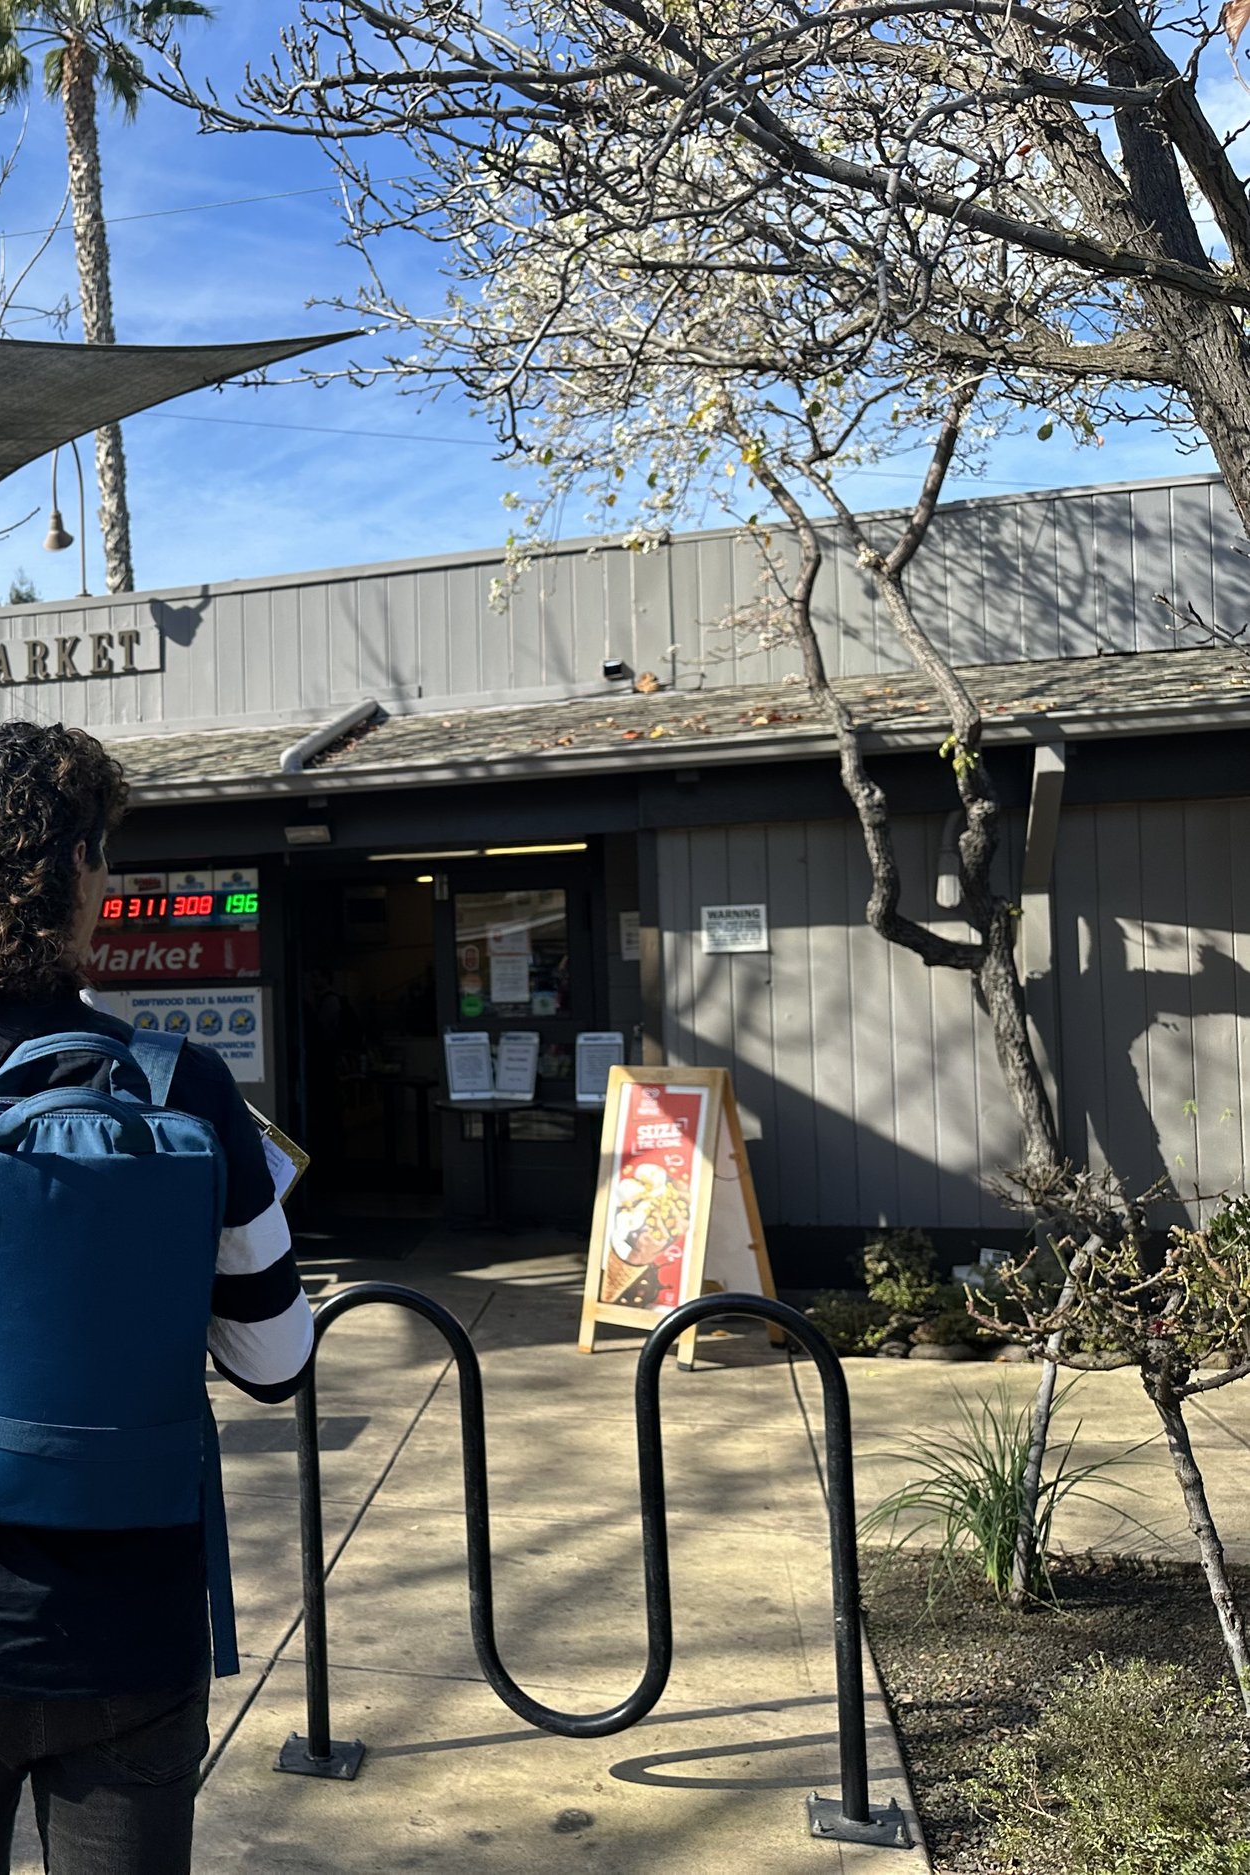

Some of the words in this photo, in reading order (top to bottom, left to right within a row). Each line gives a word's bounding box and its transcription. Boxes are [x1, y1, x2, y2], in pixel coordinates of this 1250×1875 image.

[172, 895, 213, 916] 308
[225, 893, 258, 914] 196
[707, 908, 760, 919] WARNING
[91, 941, 203, 971] Market
[132, 998, 183, 1007] DRIFTWOOD
[186, 997, 206, 1005] DELI
[217, 995, 255, 1004] MARKET
